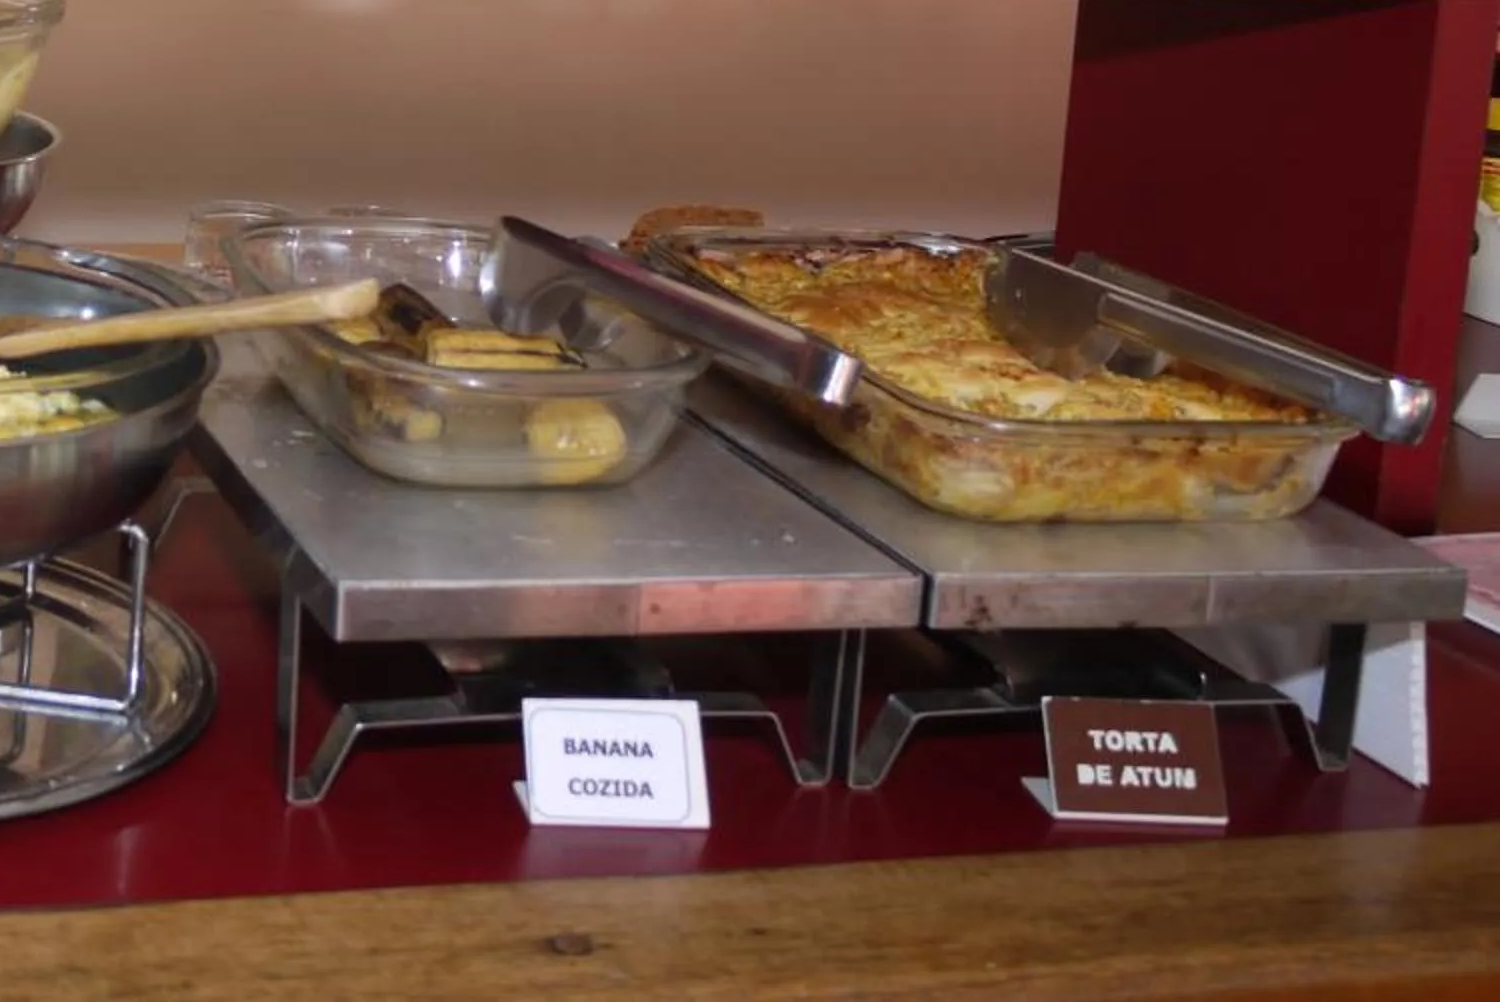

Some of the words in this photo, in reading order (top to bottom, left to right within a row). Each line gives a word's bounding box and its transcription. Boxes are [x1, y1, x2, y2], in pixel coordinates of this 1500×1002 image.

[563, 738, 654, 758] BANANA
[1087, 729, 1179, 753] TORTA
[1076, 763, 1113, 785] DE
[568, 777, 654, 799] COZIDA
